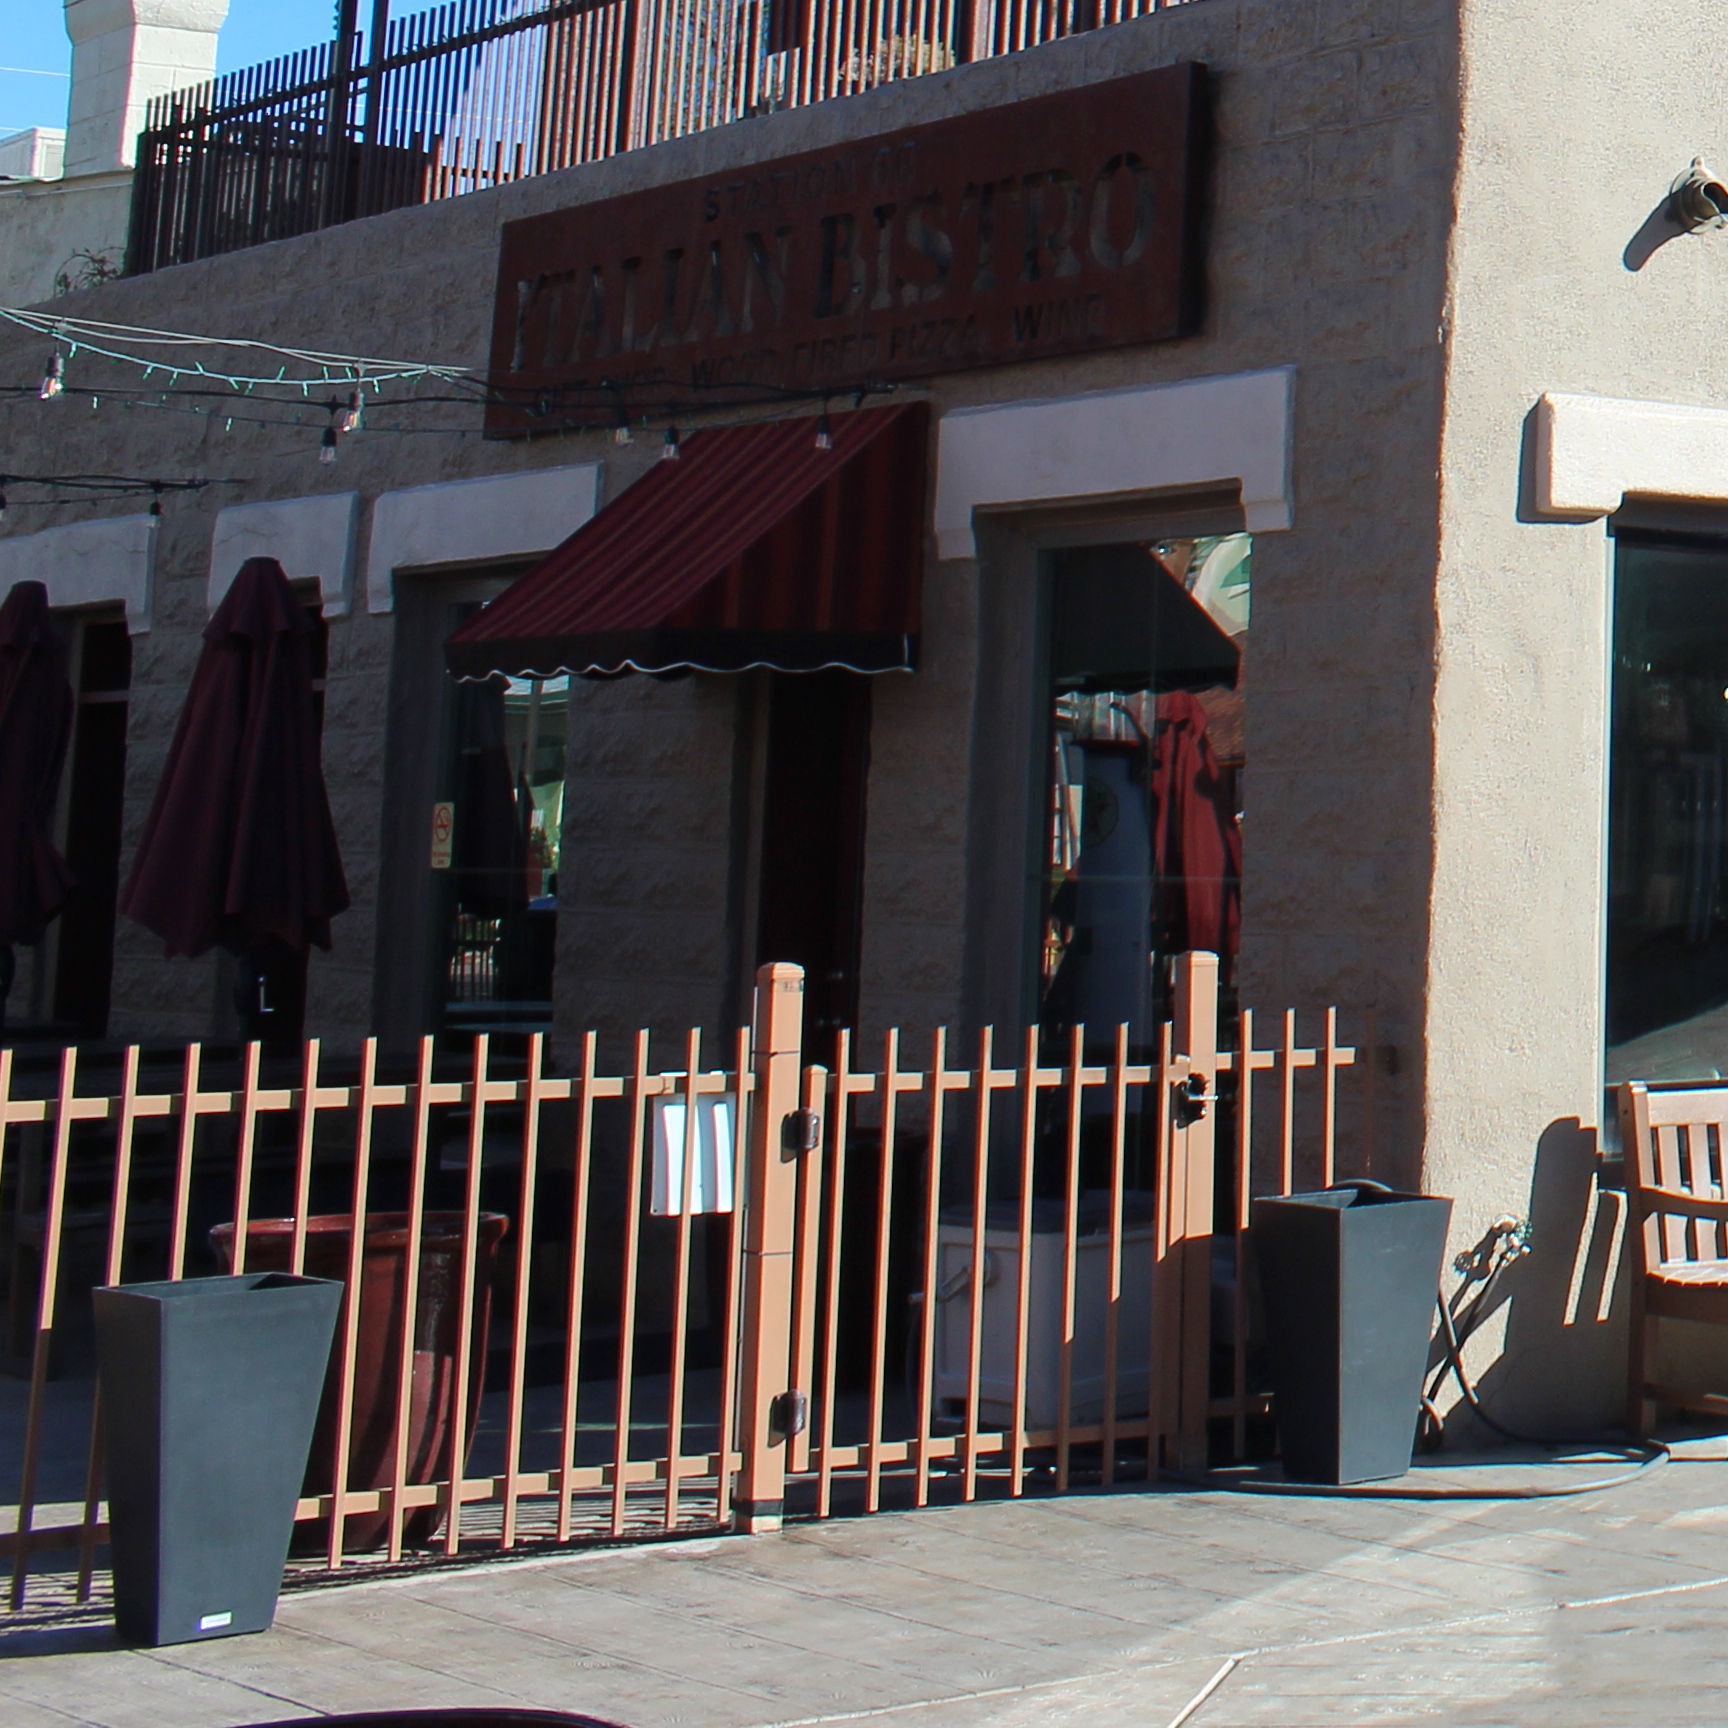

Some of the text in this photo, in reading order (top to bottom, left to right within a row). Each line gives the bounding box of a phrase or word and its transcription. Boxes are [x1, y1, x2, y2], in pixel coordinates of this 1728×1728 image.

[508, 149, 1158, 374] ITALIAN BISTRO
[1012, 292, 1106, 342] WINE
